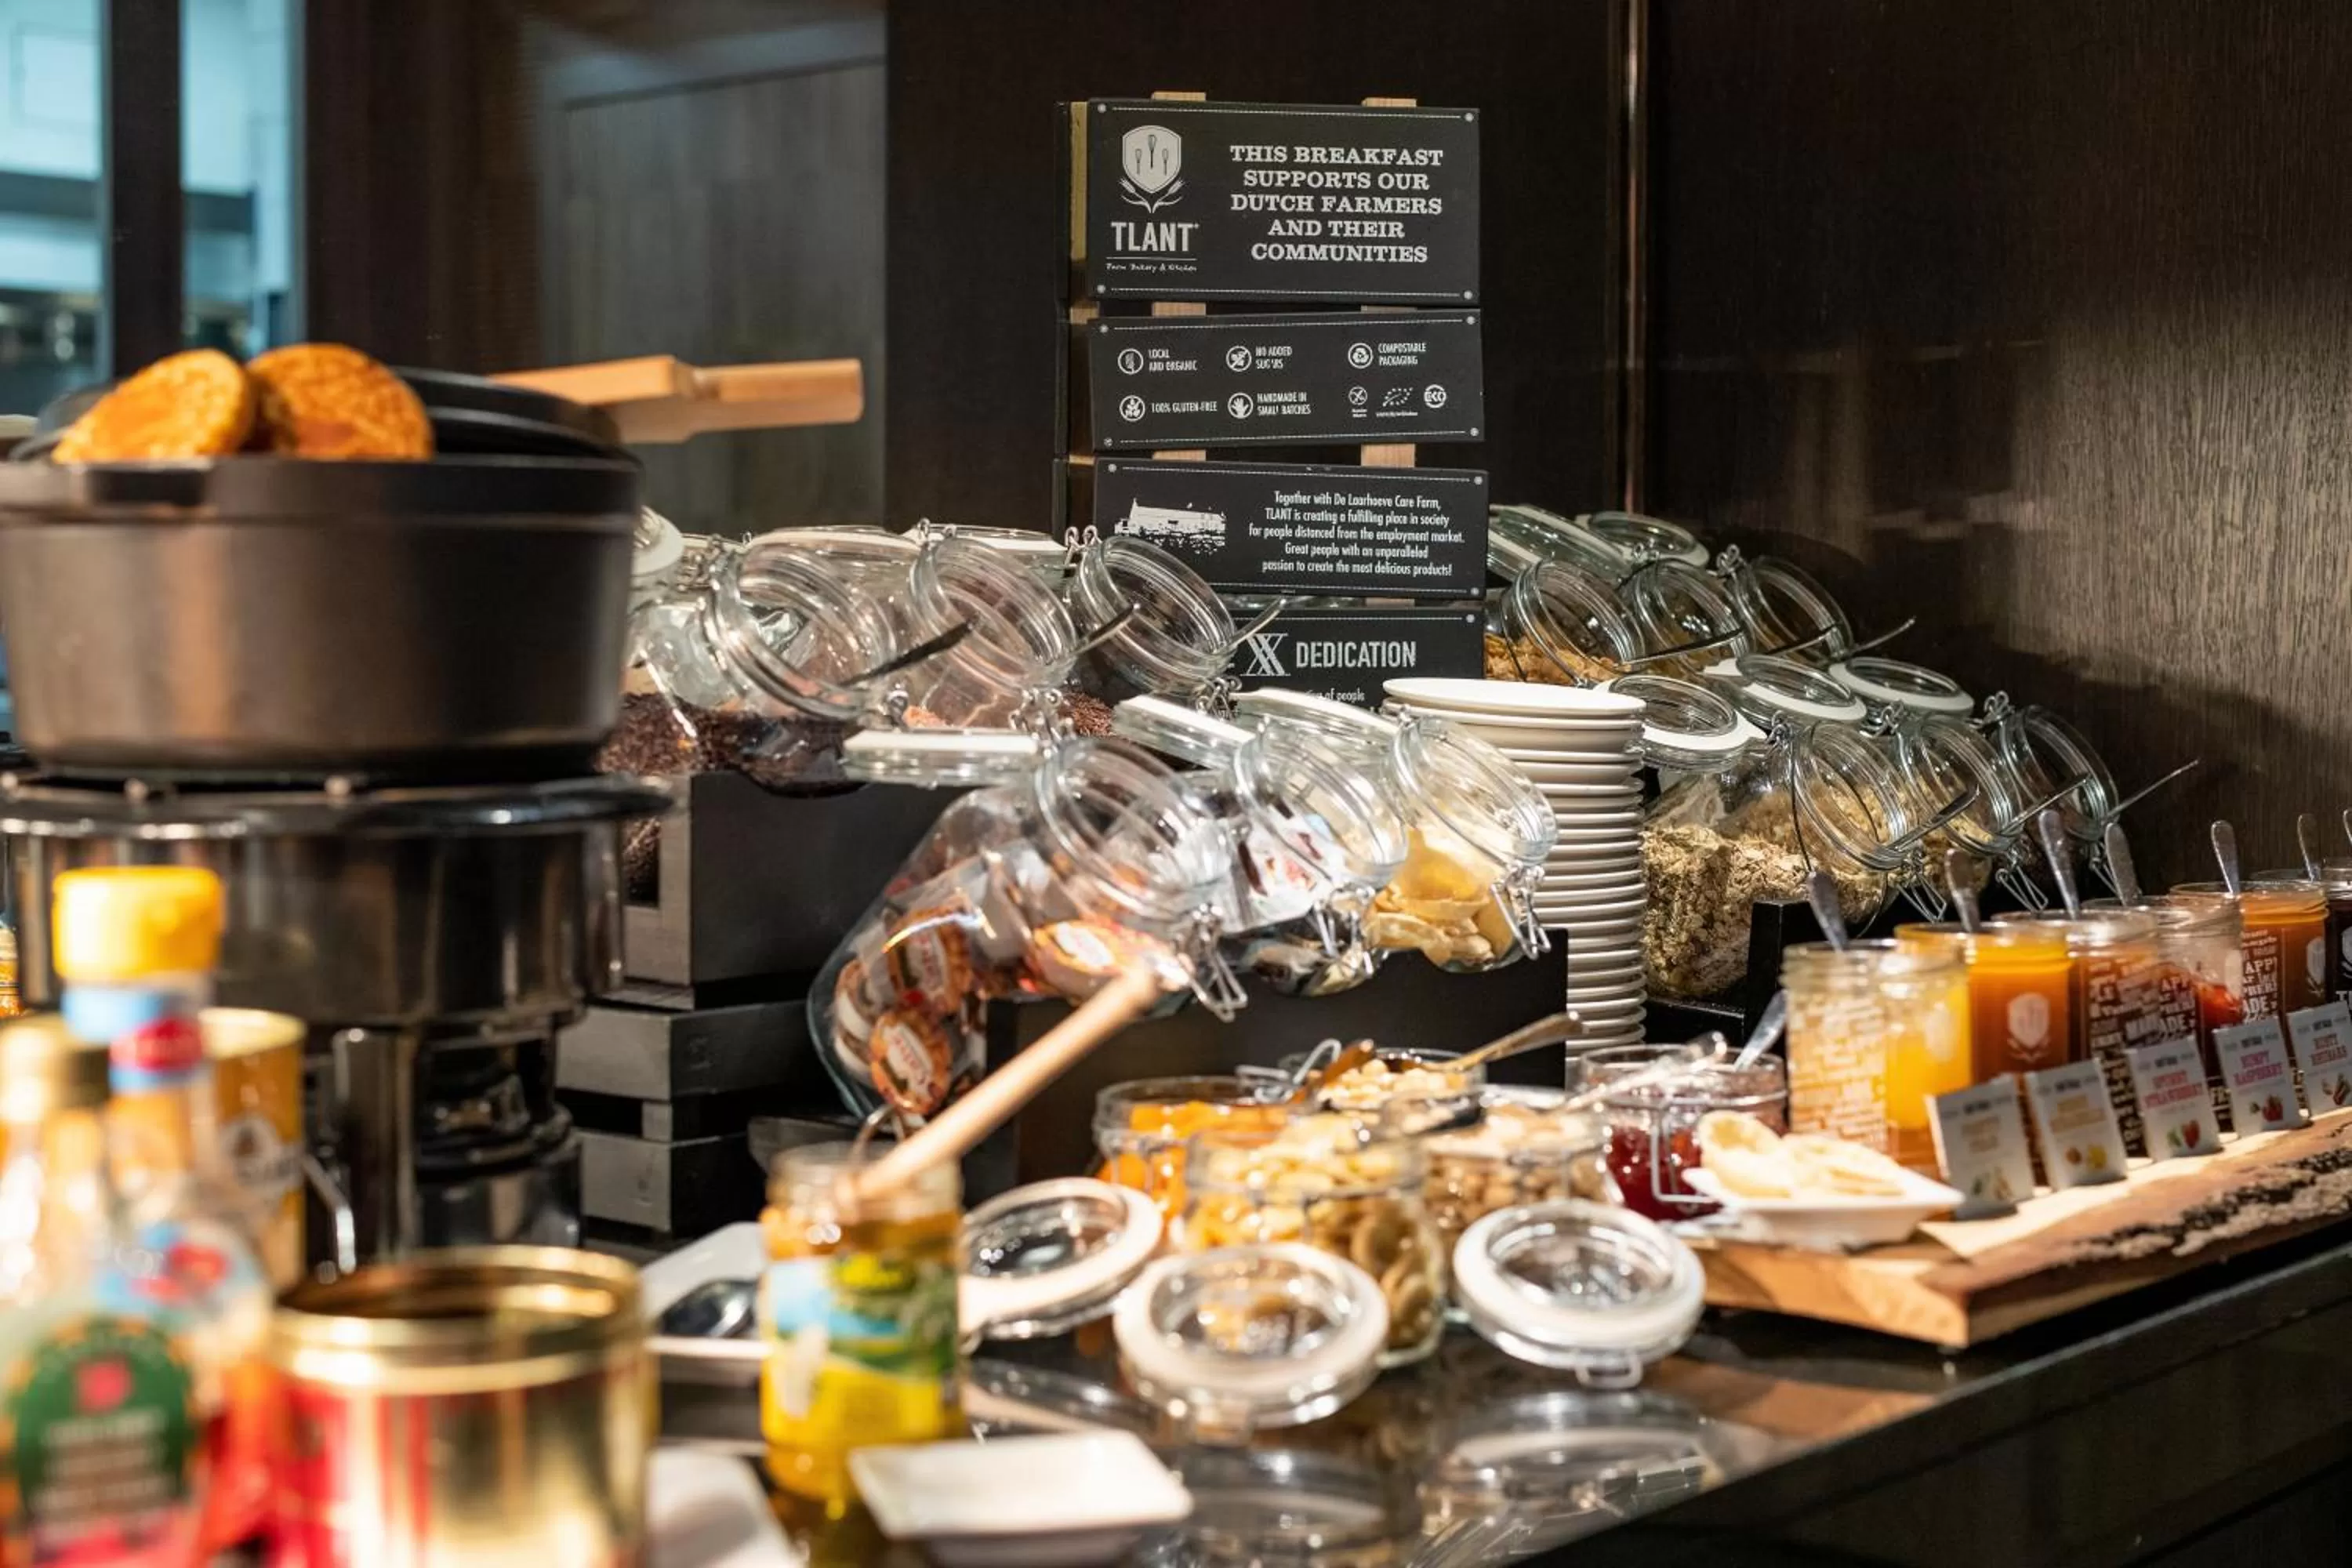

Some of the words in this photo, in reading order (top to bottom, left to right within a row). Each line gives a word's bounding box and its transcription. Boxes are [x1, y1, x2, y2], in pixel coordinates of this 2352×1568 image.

[1230, 145, 1287, 162] THIS
[1294, 147, 1443, 166] BREAKFAST
[1243, 169, 1371, 189] SUPPORTS
[1377, 172, 1430, 190] OUR
[1230, 194, 1314, 212] DUTCH
[1321, 195, 1443, 216] FARMERS
[1111, 221, 1192, 252] TLANT
[1268, 220, 1323, 237] AND
[1328, 220, 1405, 239] THEIR
[1250, 243, 1428, 263] COMMUNITIES
[1377, 342, 1427, 354] COMPOSTABLE
[1378, 355, 1418, 366] PACKAGING
[1151, 402, 1171, 413] 100%
[1257, 392, 1298, 403] HANDMADE
[1274, 490, 1312, 506] Together
[1313, 492, 1332, 506] with
[1334, 492, 1346, 506] De
[1395, 495, 1414, 507] Care
[1416, 495, 1441, 511] Farm,
[1265, 507, 1292, 521] TLANT
[1294, 509, 1301, 521] is
[1302, 510, 1338, 524] creating
[1339, 514, 1346, 522] a
[1348, 509, 1384, 526] fulfilling
[1385, 510, 1408, 527] place
[1410, 512, 1418, 524] in
[1420, 514, 1450, 528] society
[1249, 522, 1262, 537] for
[1263, 524, 1293, 540] people
[1294, 524, 1335, 539] distanced
[1337, 525, 1358, 539] from
[1360, 526, 1374, 540] the
[1376, 527, 1429, 543] employment
[1431, 529, 1465, 543] market.
[1285, 542, 1308, 555] Great
[1310, 542, 1340, 558] people
[1341, 543, 1360, 556] with
[1362, 547, 1374, 557] an
[1375, 544, 1428, 561] unparalleled
[1262, 559, 1294, 573] passion
[1296, 561, 1305, 572] to
[1307, 561, 1334, 572] create
[1335, 559, 1349, 573] the
[1351, 563, 1373, 574] most
[1374, 560, 1412, 575] delicious
[1413, 561, 1452, 578] products!
[1295, 641, 1417, 668] DEDICATION
